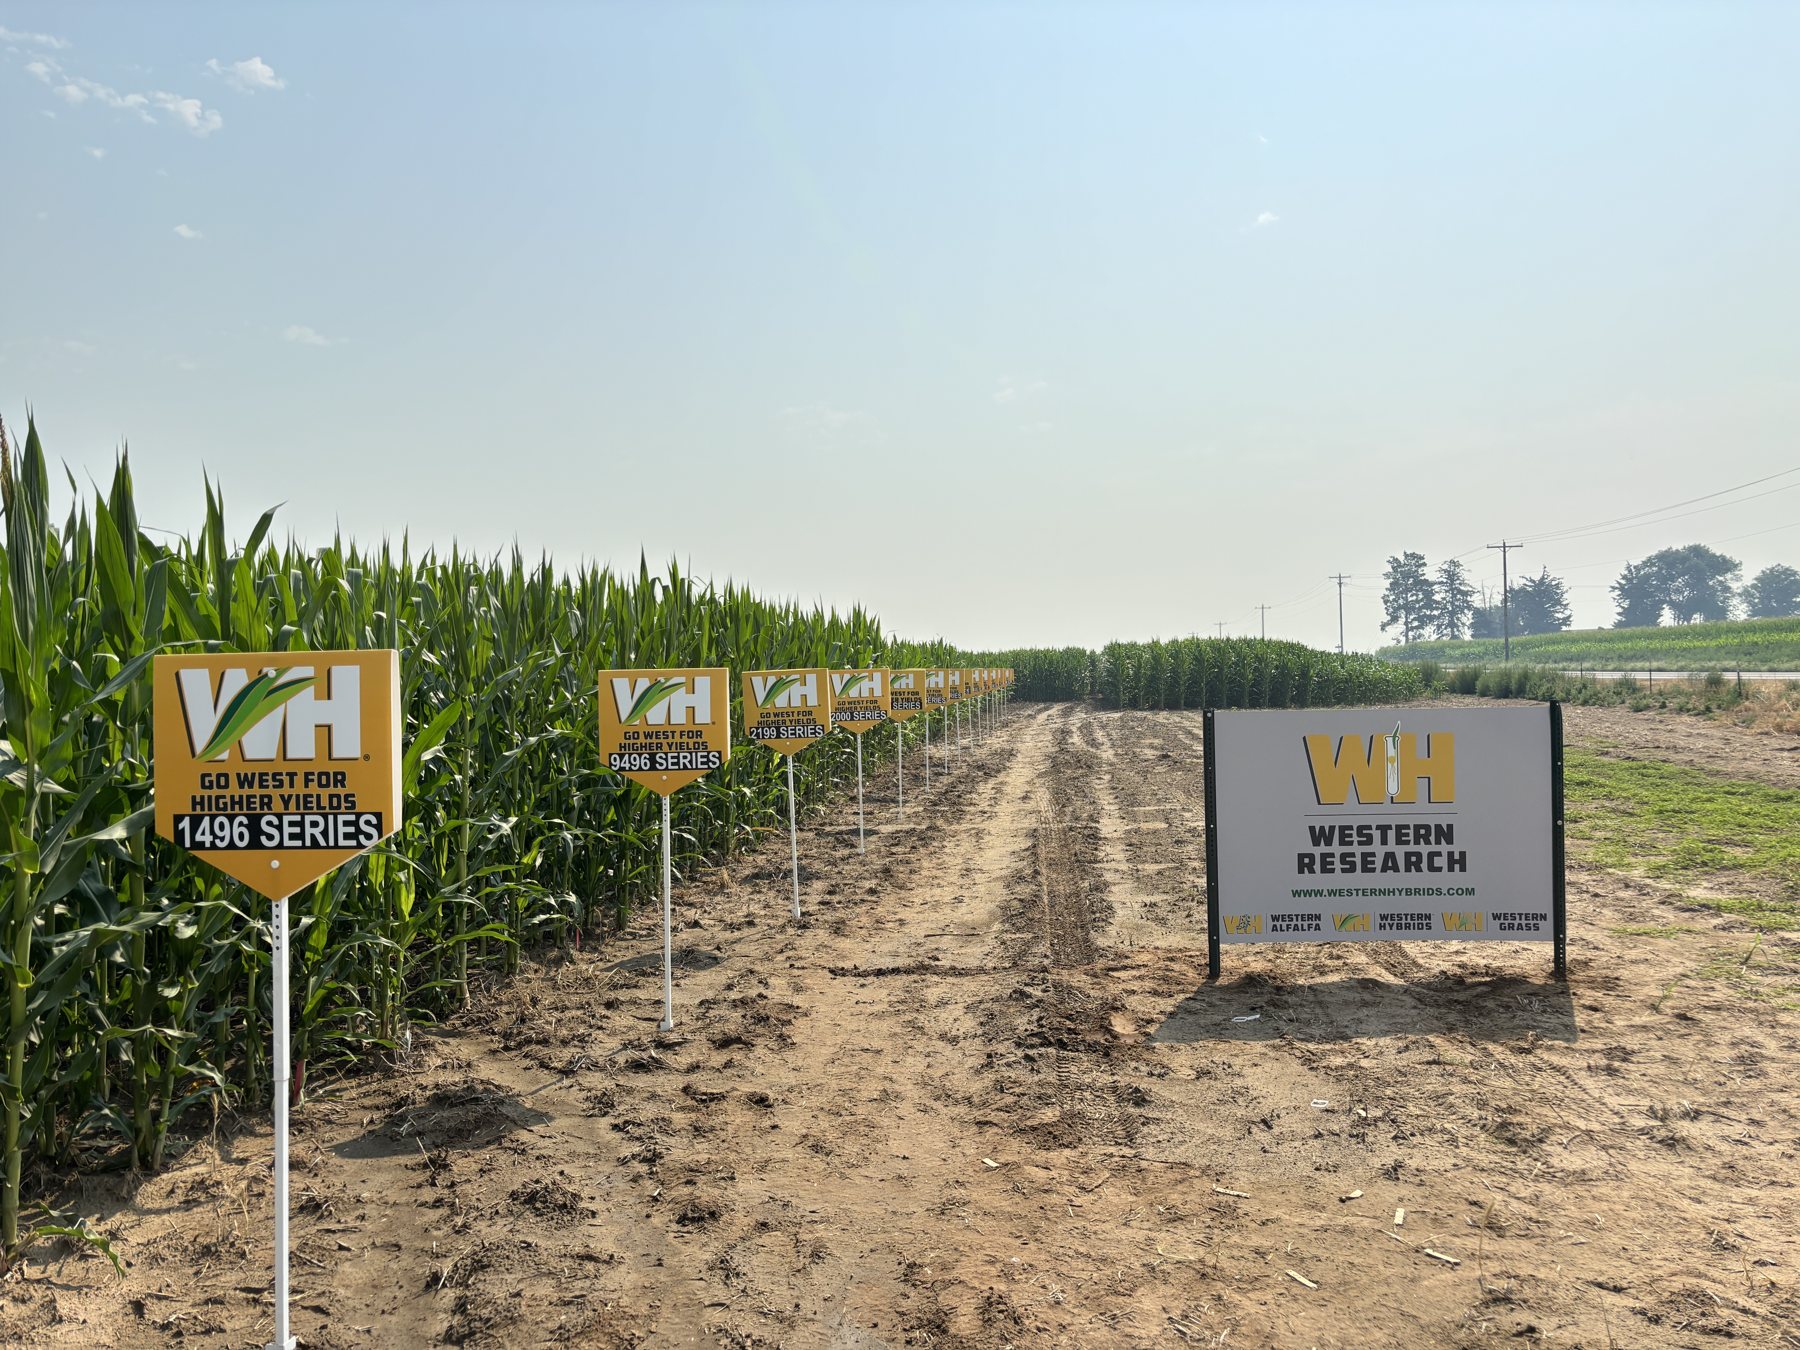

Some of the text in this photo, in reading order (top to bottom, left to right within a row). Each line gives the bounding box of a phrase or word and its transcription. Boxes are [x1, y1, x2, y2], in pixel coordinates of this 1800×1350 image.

[893, 702, 920, 710] SERIES
[831, 711, 886, 721] 2000 SERIES
[624, 730, 703, 740] GO WEST FOR
[751, 726, 823, 738] 2199 SERIES
[619, 742, 708, 751] HIGHER YIELDS
[611, 752, 719, 770] 9496 SERIES
[1303, 732, 1456, 805] WH
[201, 771, 347, 790] GO WEST FOR
[191, 793, 356, 812] HIGHER YIELDS
[178, 814, 378, 848] 1496 SERIES
[1308, 824, 1454, 847] WESTERN
[1298, 851, 1467, 874] RESEARCH
[1291, 887, 1475, 898] WWW.WESTERNHYBRIDS.COM
[1271, 913, 1322, 922] WESTERN
[1379, 913, 1431, 922] WESTERN
[1492, 912, 1547, 921] WESTERN
[1271, 923, 1321, 932] ALFALFA
[1379, 923, 1432, 931] HYBRIDS
[1499, 923, 1540, 931] GRASS
